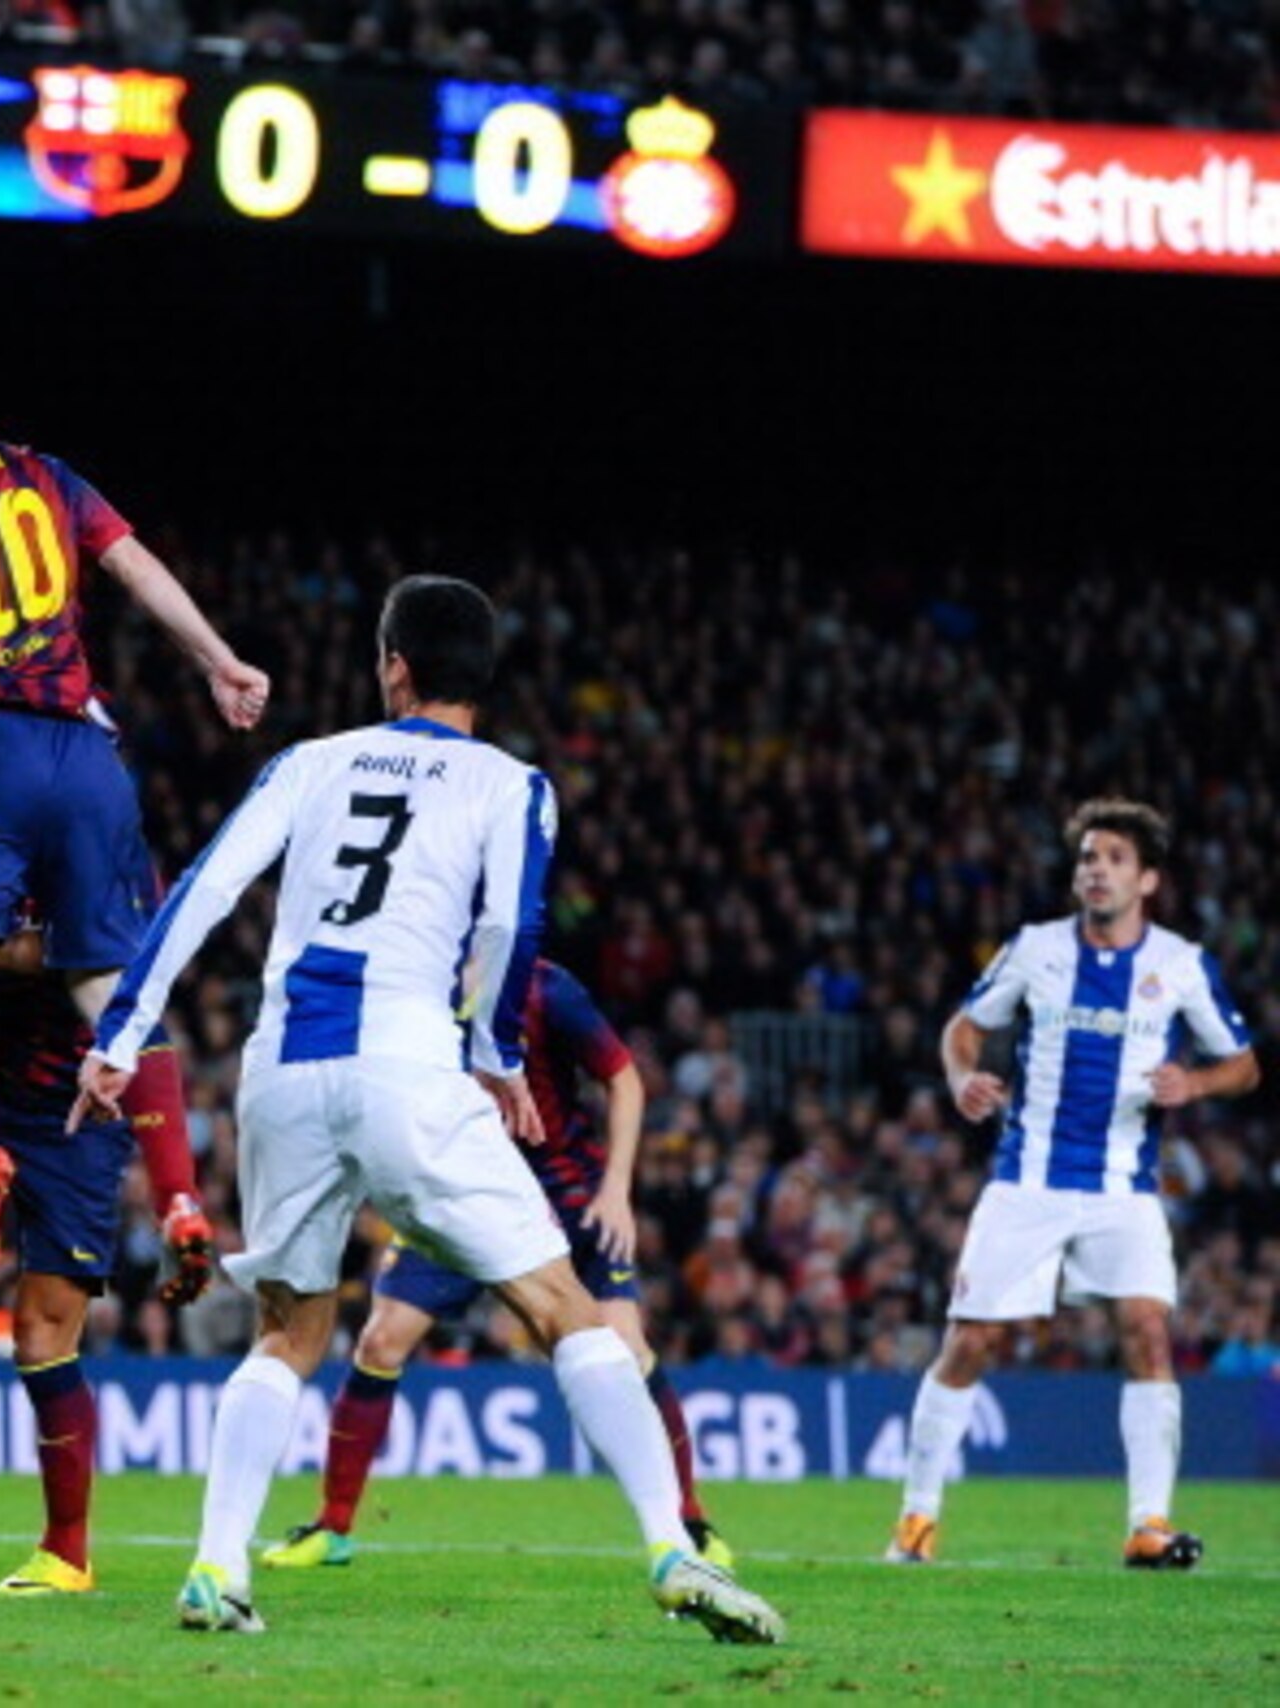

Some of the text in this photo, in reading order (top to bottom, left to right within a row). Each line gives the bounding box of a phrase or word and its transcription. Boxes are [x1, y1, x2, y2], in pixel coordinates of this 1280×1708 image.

[217, 82, 320, 219] 0
[475, 101, 571, 234] 0
[320, 791, 415, 926] 3
